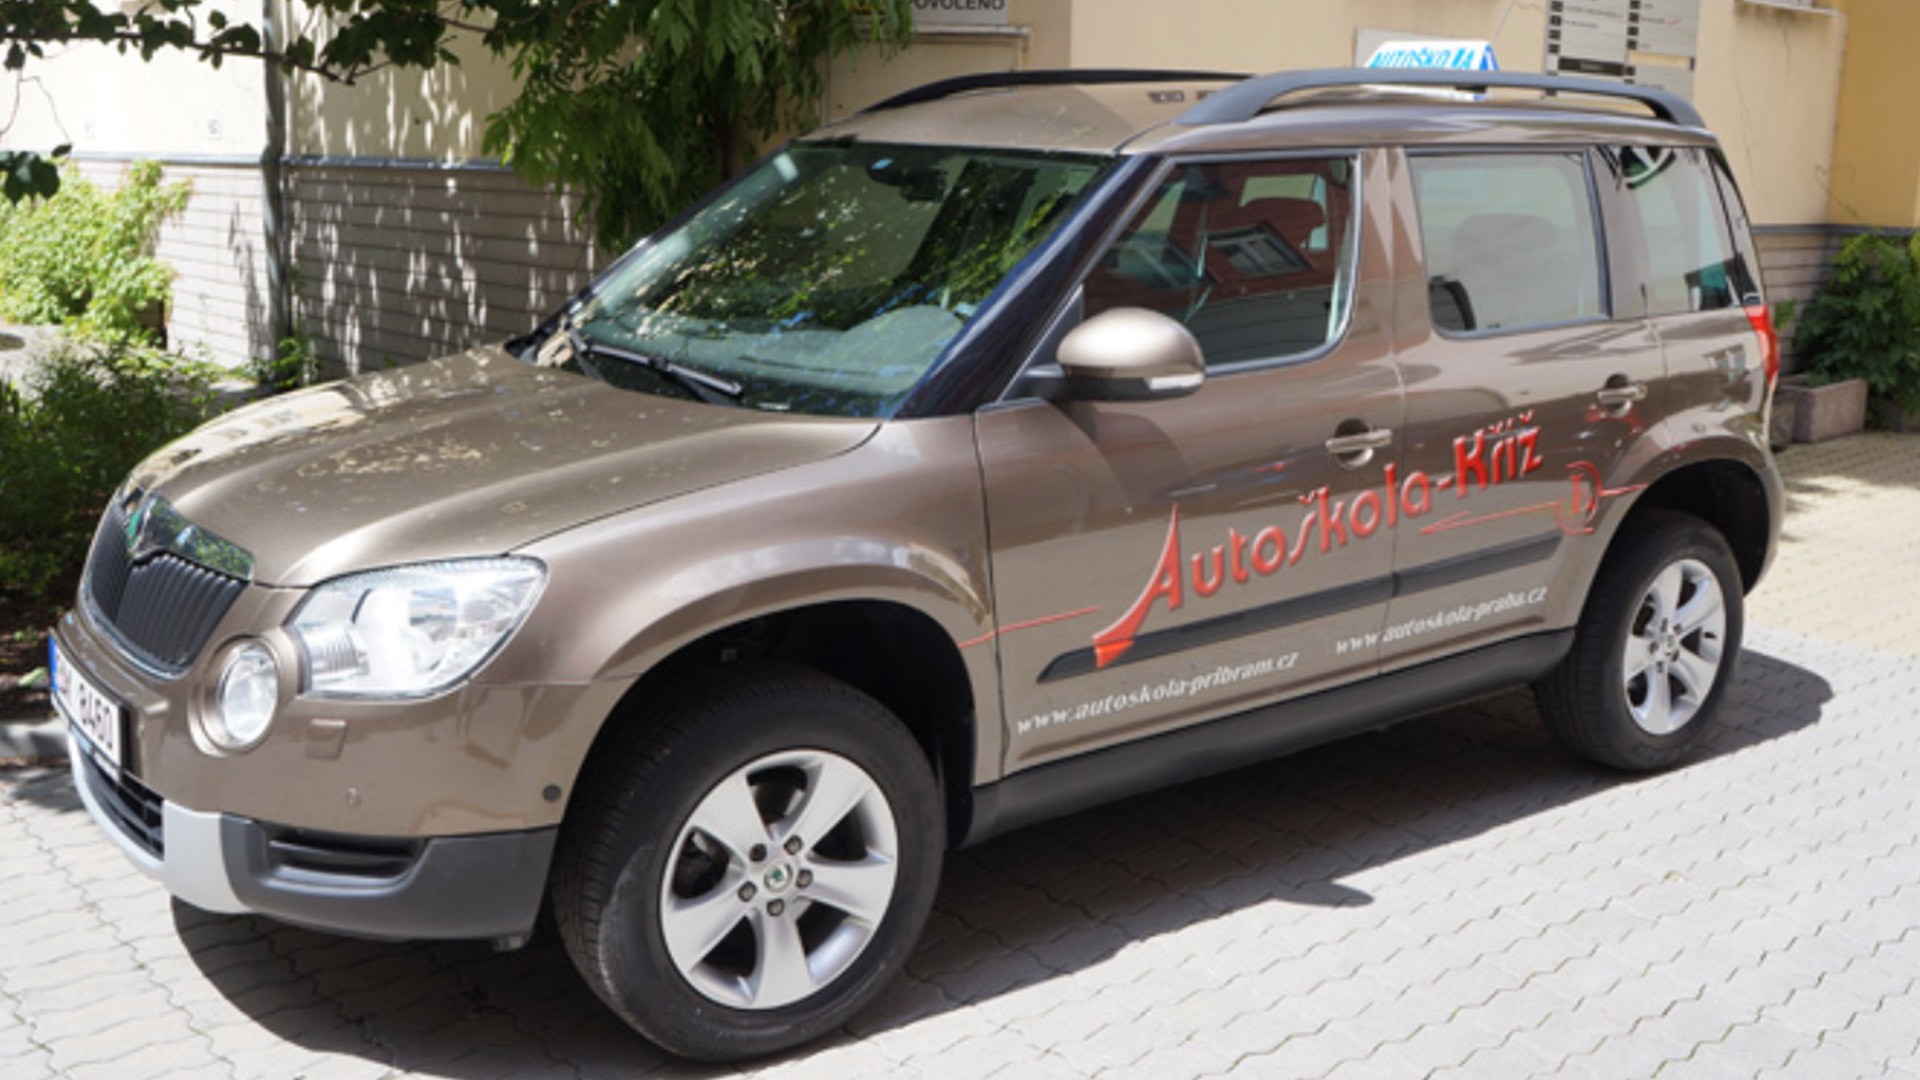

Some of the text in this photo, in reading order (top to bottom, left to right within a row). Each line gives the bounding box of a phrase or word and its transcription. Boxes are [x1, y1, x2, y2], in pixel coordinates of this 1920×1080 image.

[911, 0, 1005, 11] OVOLENO
[1092, 411, 1544, 668] Autoškola-Kříž
[1335, 586, 1548, 655] www.autoskola-praha.cz
[1017, 651, 1300, 735] www.autoskola-pribram.cz
